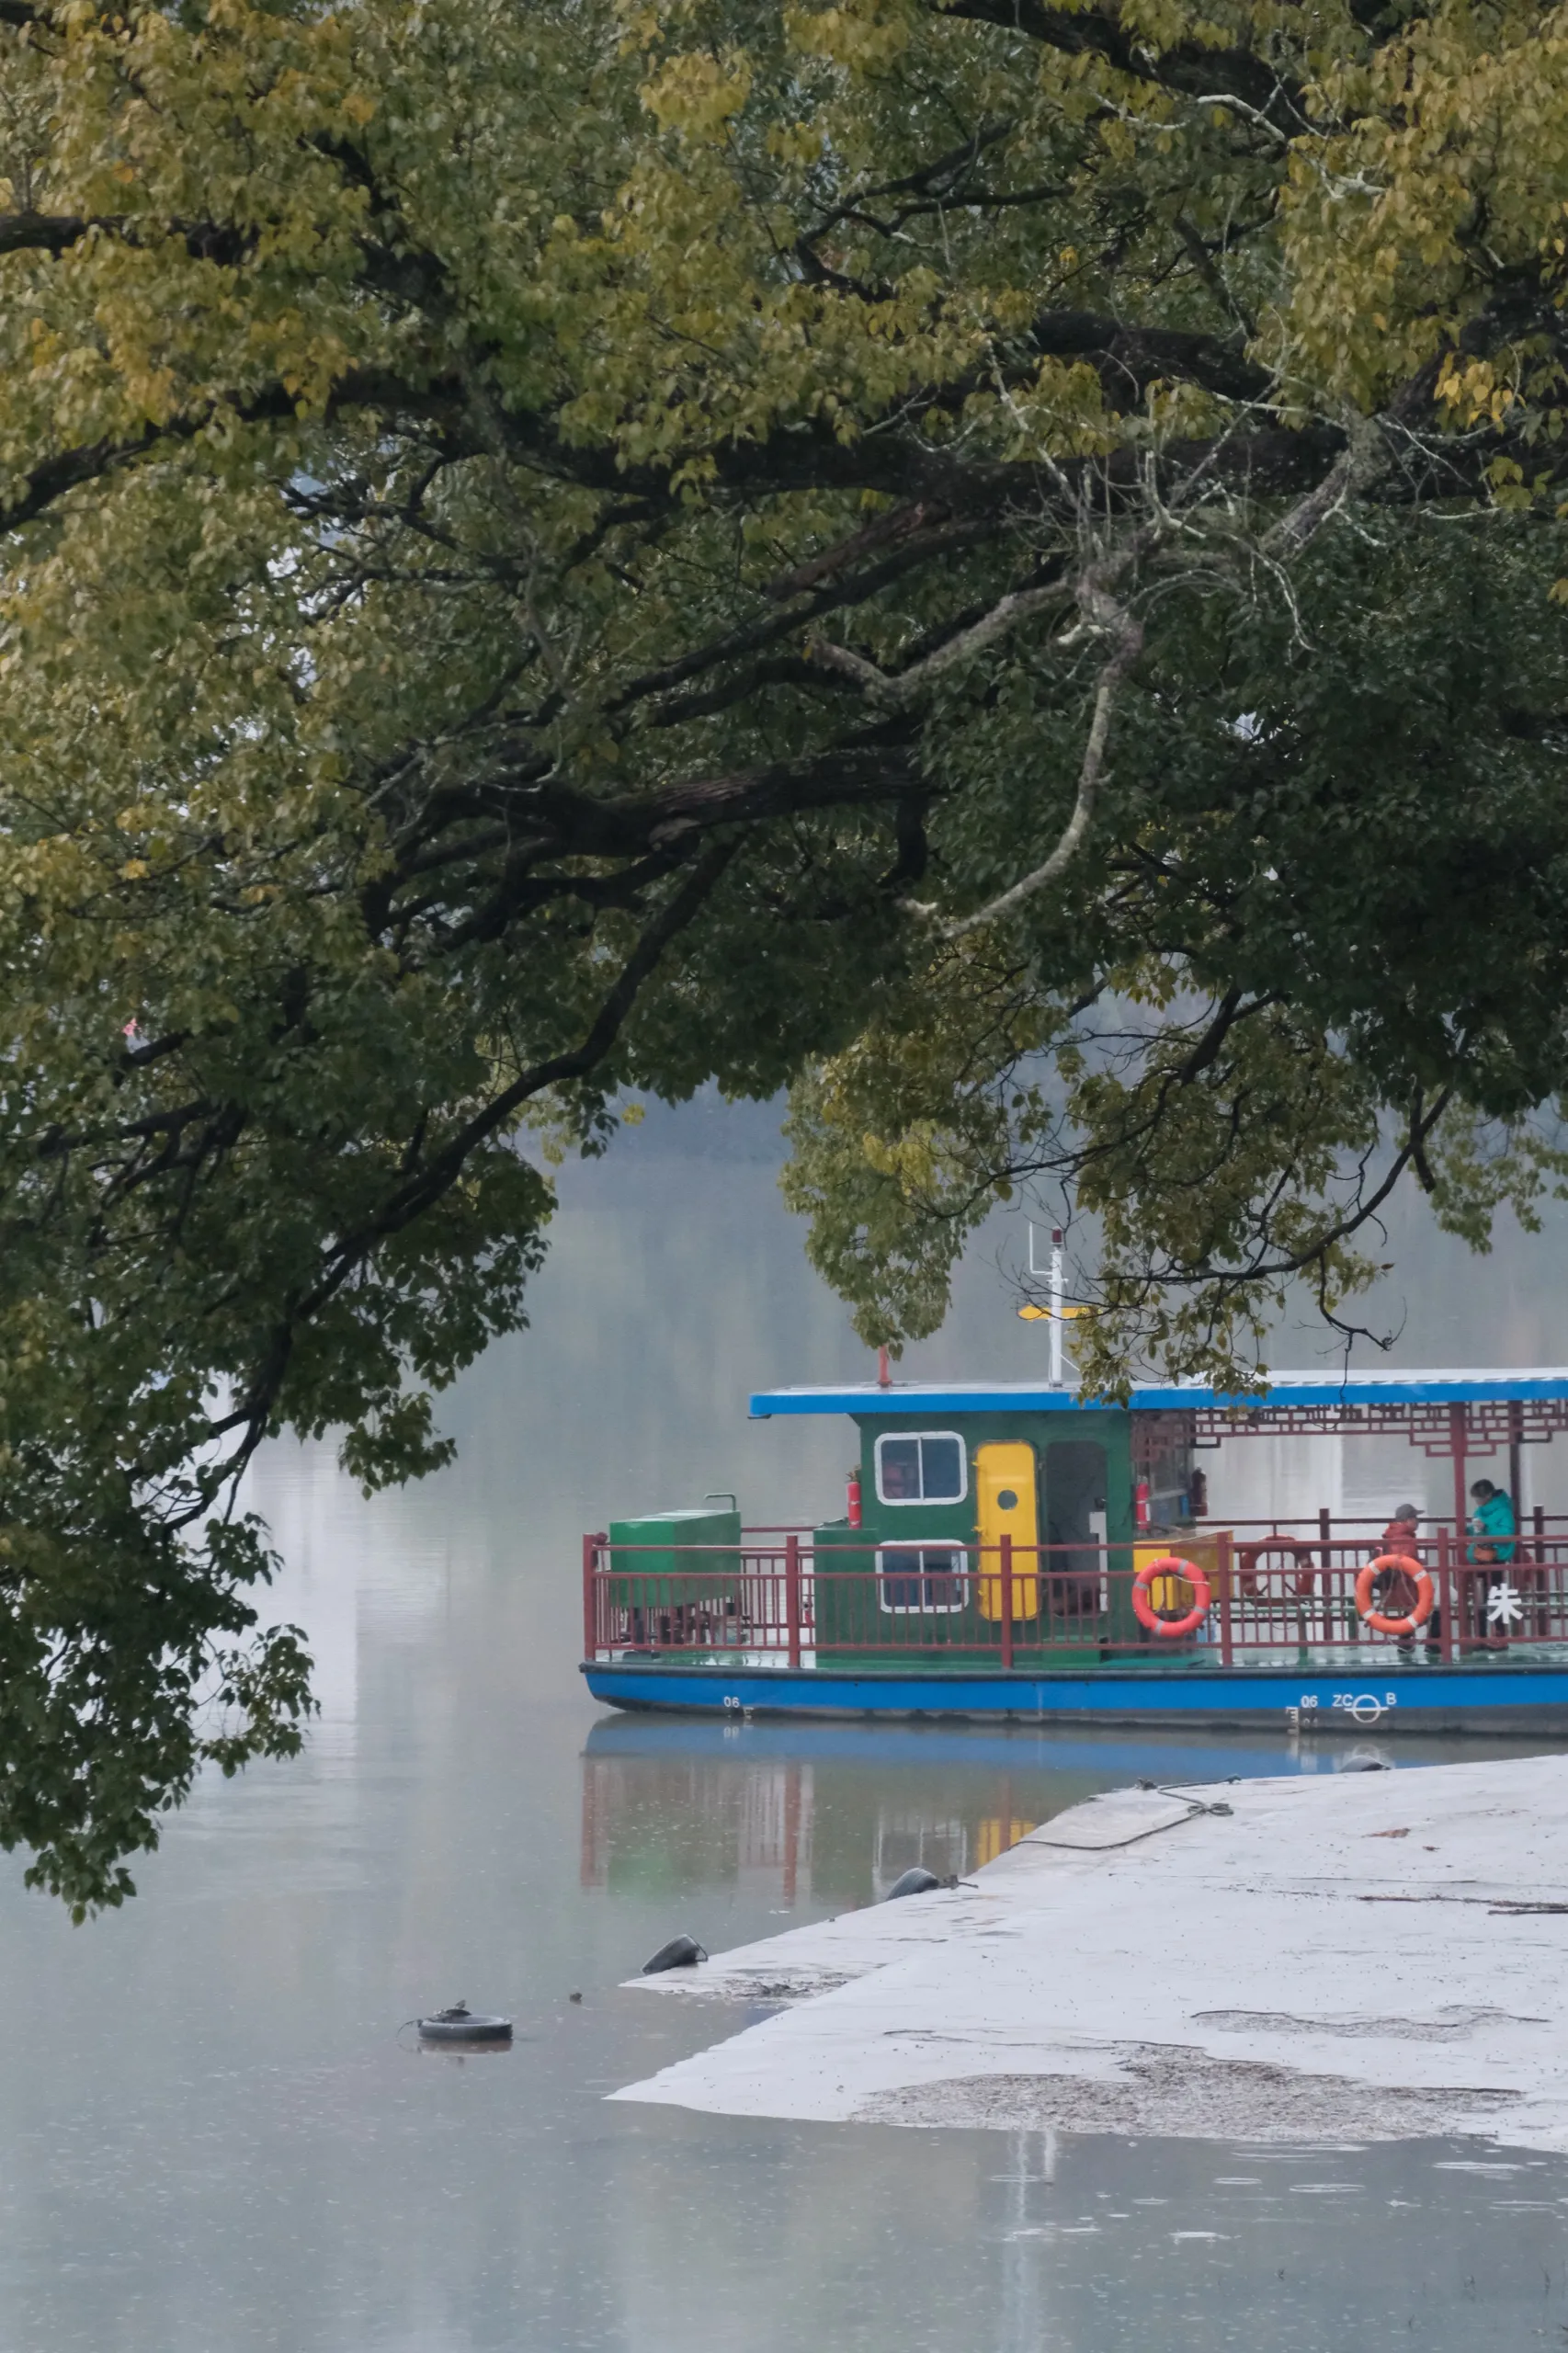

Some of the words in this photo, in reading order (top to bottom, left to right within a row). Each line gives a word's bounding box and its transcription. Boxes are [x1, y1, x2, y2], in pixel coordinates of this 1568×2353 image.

[1487, 1583, 1523, 1624] 朱
[723, 1696, 740, 1708] 06
[1301, 1695, 1318, 1708] 06
[1332, 1694, 1353, 1707] ZC
[1386, 1692, 1397, 1705] B
